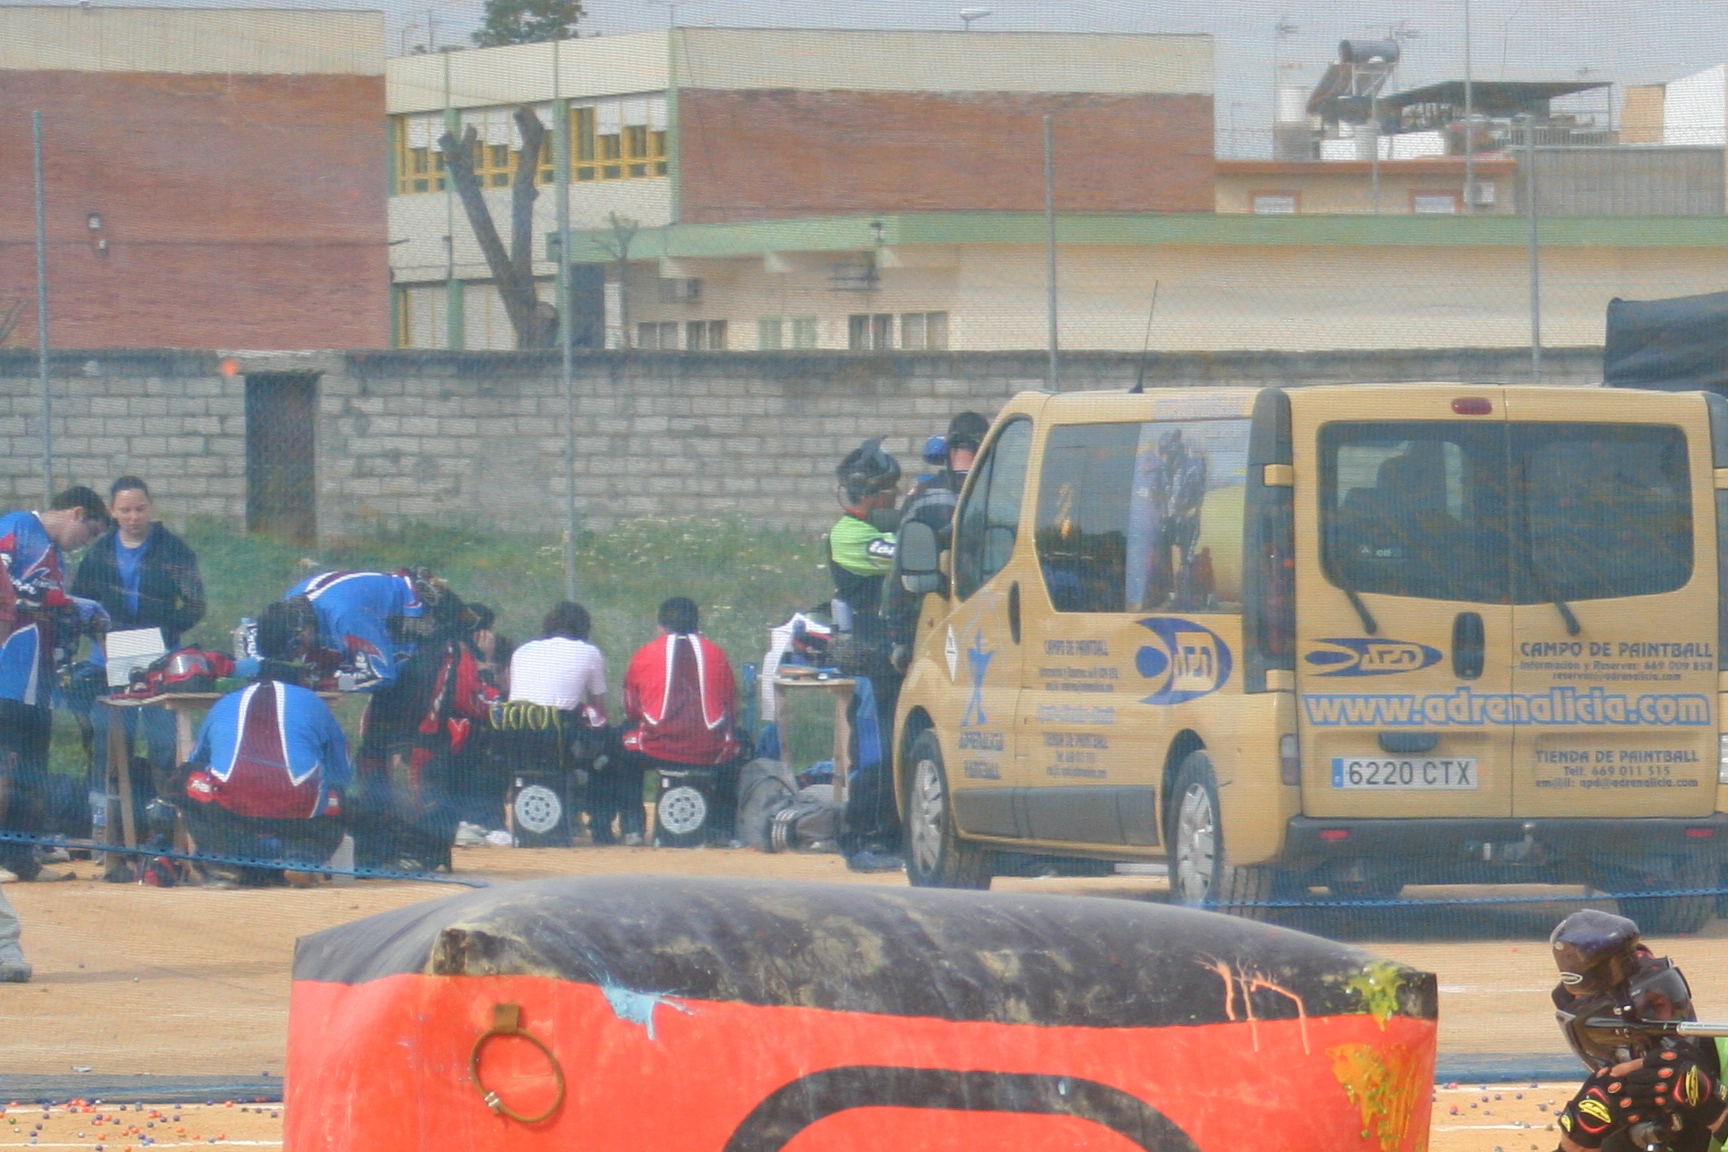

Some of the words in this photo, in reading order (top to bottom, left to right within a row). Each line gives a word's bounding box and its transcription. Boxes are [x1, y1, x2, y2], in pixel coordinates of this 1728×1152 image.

[1520, 642, 1583, 657] CAMPO
[1589, 642, 1612, 657] DE
[1618, 642, 1713, 658] PAINTBALL
[1303, 686, 1711, 725] www.adrenalicia.com
[1536, 750, 1589, 763] TIENDA
[1594, 750, 1613, 763] DE
[1619, 750, 1699, 763] PAINTBALL
[1348, 761, 1413, 785] 6220
[1423, 761, 1470, 785] CTX
[1591, 766, 1614, 776] 669
[1619, 766, 1641, 776] 011
[1649, 766, 1671, 776] 515
